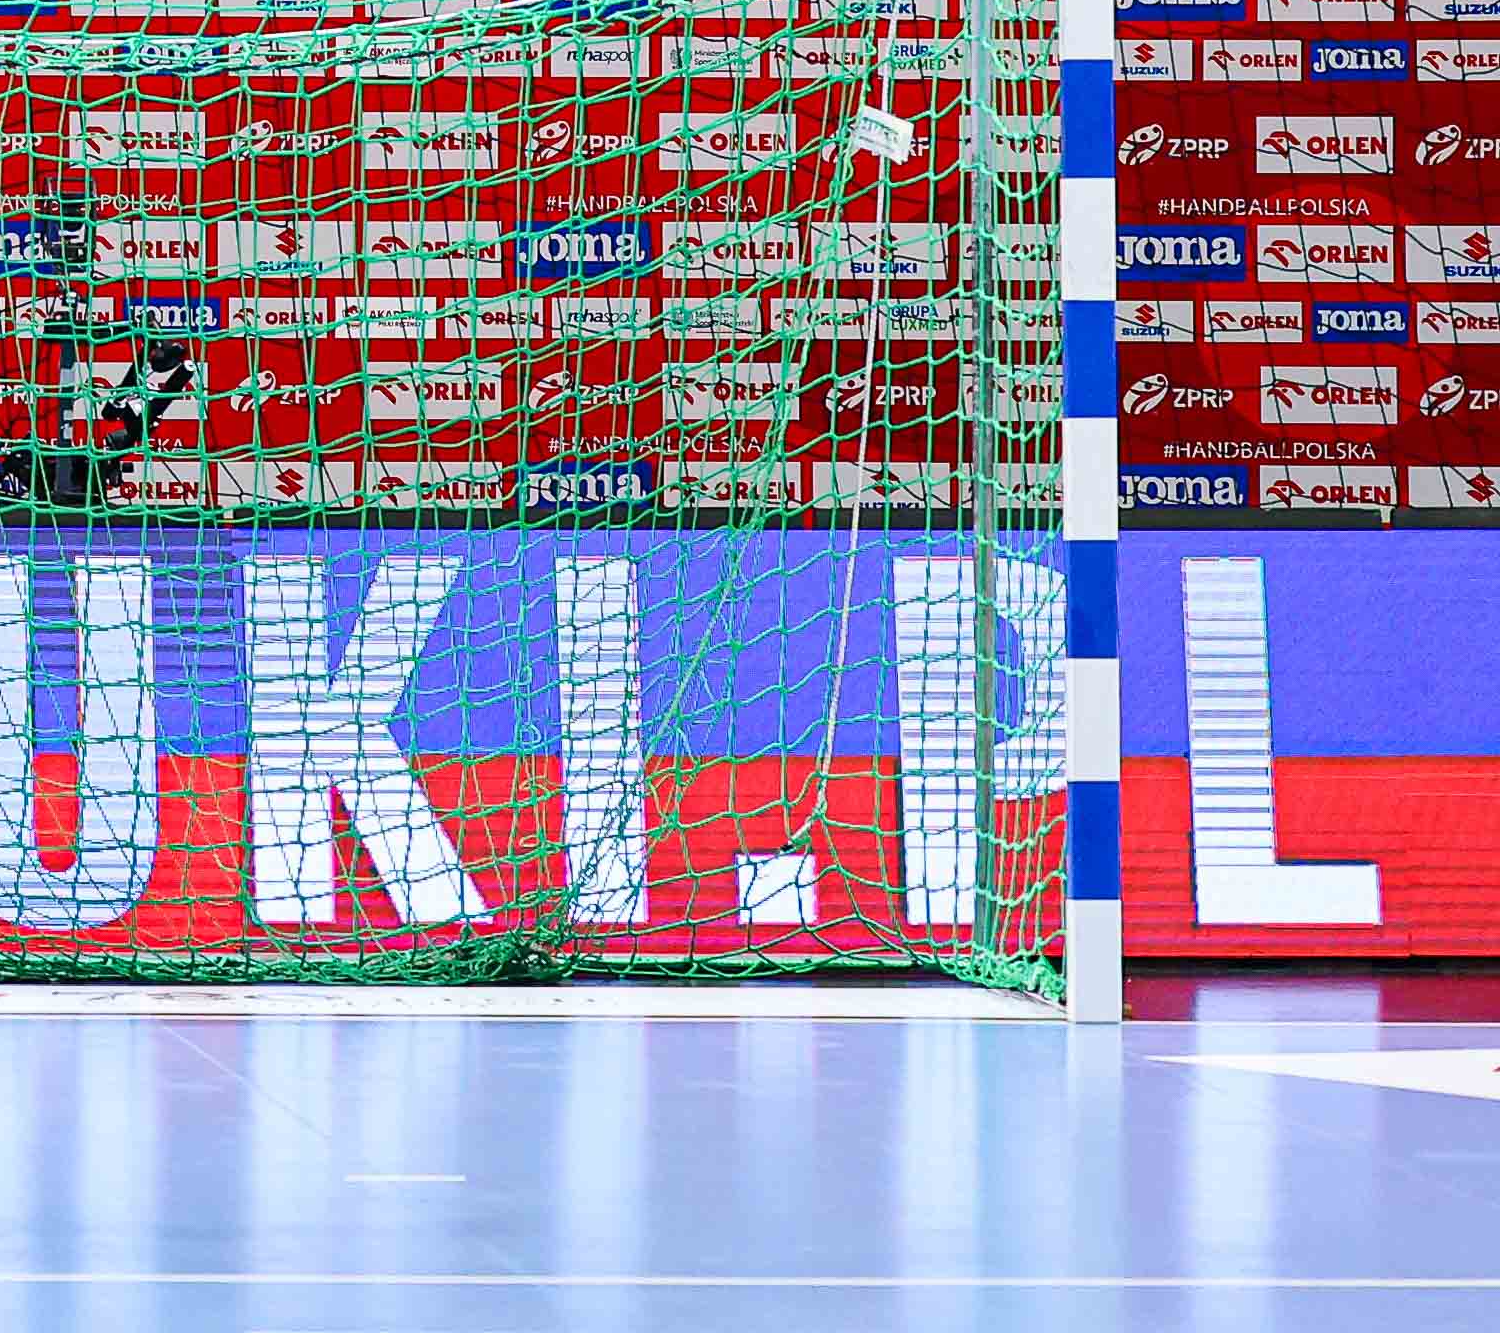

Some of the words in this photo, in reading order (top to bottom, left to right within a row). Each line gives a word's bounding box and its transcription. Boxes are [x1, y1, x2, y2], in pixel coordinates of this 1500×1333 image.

[1239, 53, 1298, 67] ORLEN
[1453, 53, 1500, 67] ORLE
[1120, 66, 1169, 75] SUZUKI
[123, 132, 201, 150] ORLEN
[412, 132, 493, 150] ORLEN
[574, 135, 636, 155] ZPRP
[710, 133, 788, 151] ORLEN
[1010, 135, 1061, 154] ORL
[1168, 138, 1229, 158] ZPRP
[1307, 136, 1387, 155] ORLEN
[1465, 138, 1500, 158] ZP
[1157, 197, 1370, 217] #HANDBALLPOLSKA
[122, 240, 200, 259] ORLEN
[417, 241, 495, 259] ORLEN
[713, 241, 793, 259] ORLEN
[1308, 245, 1388, 264] ORLEN
[850, 262, 918, 274] SUZUKI
[265, 311, 324, 325] ORLEN
[480, 311, 539, 325] ORLEN
[808, 311, 866, 326] ORLEN
[891, 305, 940, 319] GRUPA
[1240, 315, 1299, 329] ORLEN
[1453, 316, 1500, 330] ORLE
[1121, 327, 1170, 337] SUZUKI
[417, 382, 496, 400] ORLEN
[713, 383, 795, 402] ORLEN
[876, 385, 938, 406] ZPRP
[1011, 384, 1061, 403] ORL
[1172, 388, 1234, 408] ZPRP
[1311, 386, 1392, 406] ORLEN
[1469, 389, 1500, 410] ZP
[1163, 440, 1377, 461] #HANDBALLPOLSKA
[119, 481, 199, 500] ORLEN
[418, 482, 497, 500] ORLEN
[714, 481, 796, 500] ORLEN
[1310, 484, 1392, 503] ORLEN
